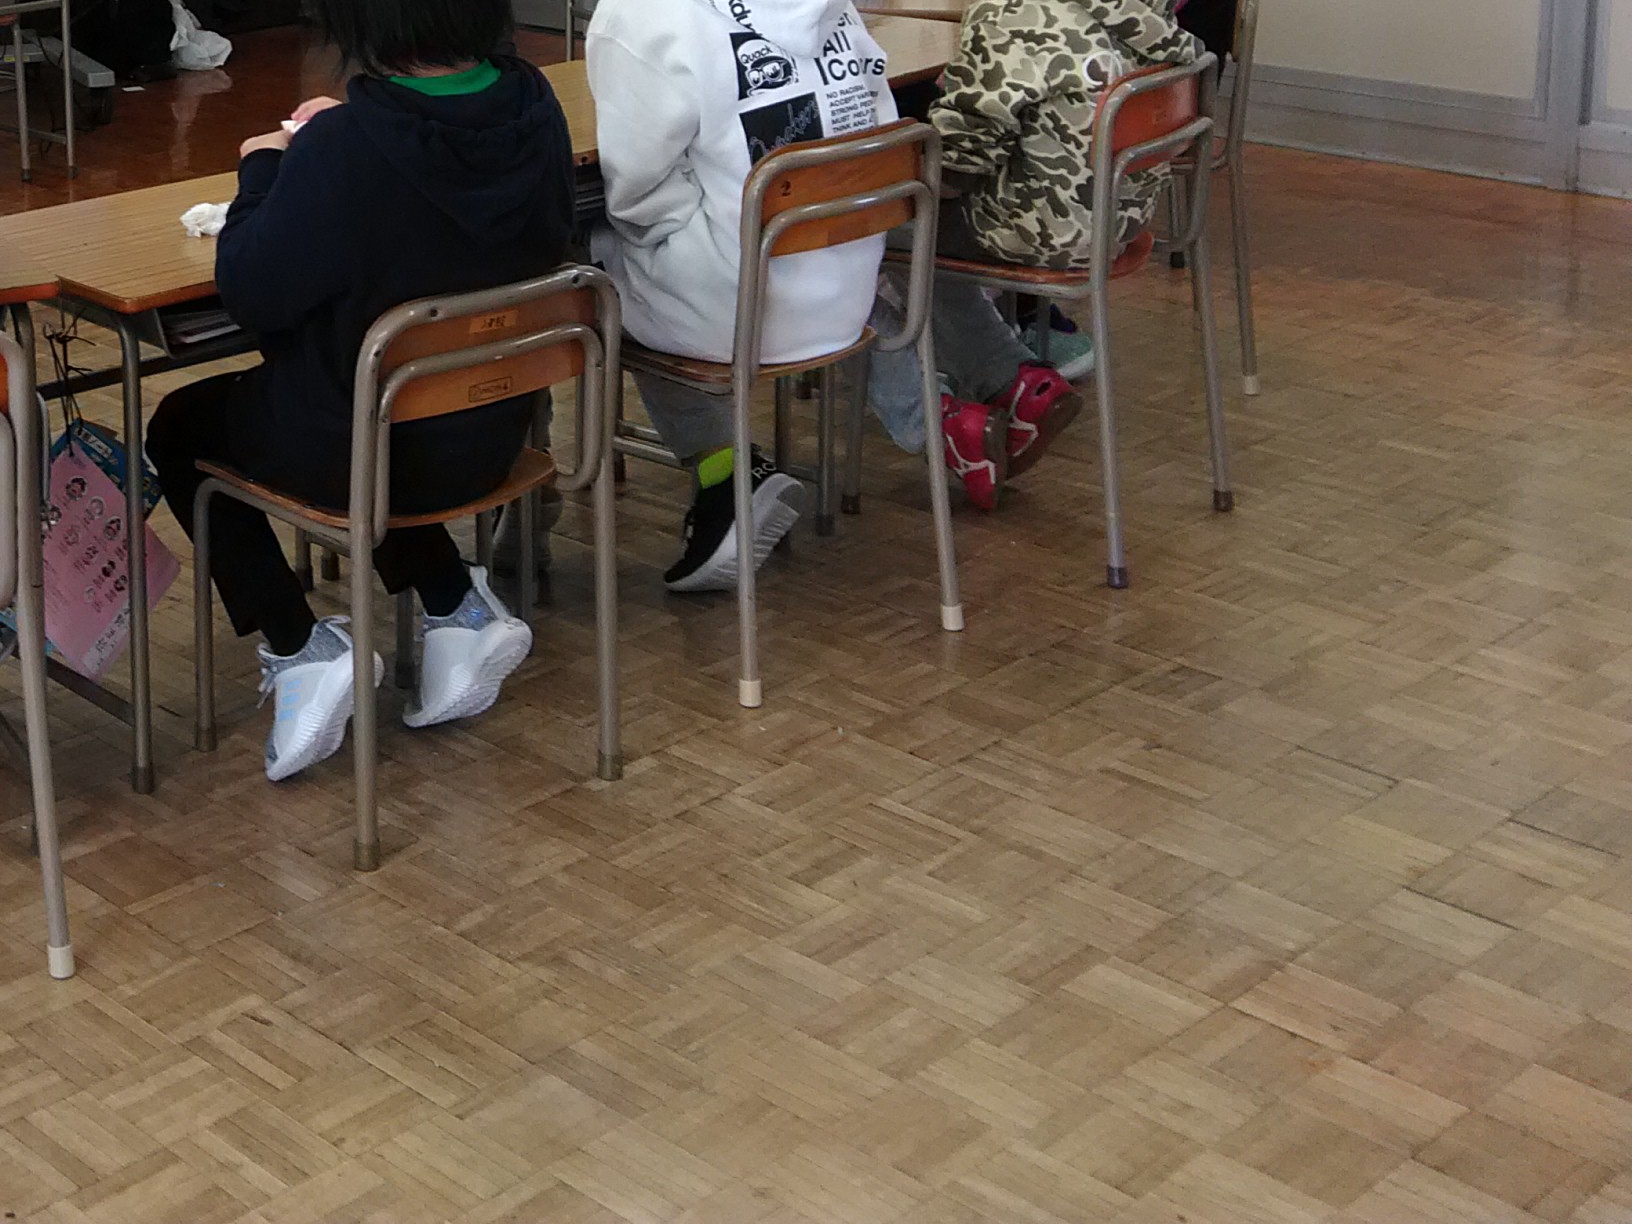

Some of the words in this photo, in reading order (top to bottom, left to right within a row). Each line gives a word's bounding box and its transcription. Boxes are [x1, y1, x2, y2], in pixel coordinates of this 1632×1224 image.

[823, 30, 851, 57] All
[740, 45, 773, 64] Quack
[826, 91, 838, 99] NO
[781, 180, 791, 196] 2
